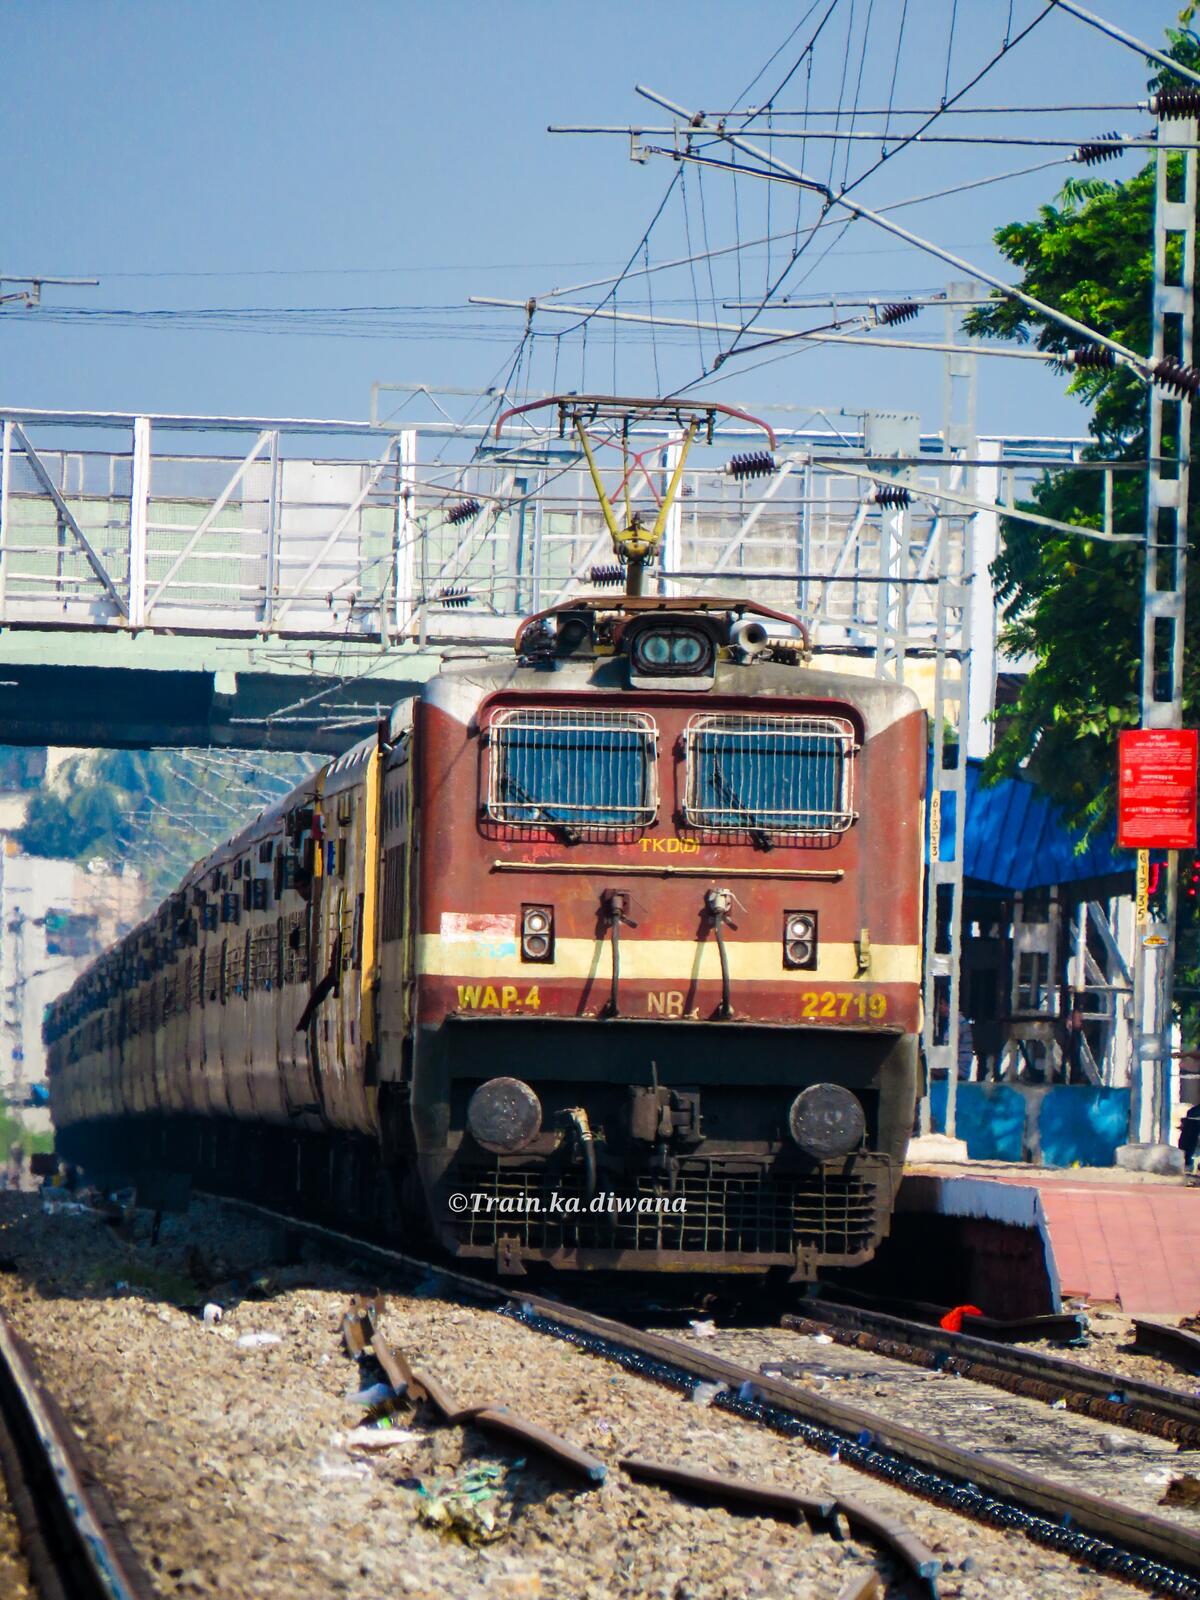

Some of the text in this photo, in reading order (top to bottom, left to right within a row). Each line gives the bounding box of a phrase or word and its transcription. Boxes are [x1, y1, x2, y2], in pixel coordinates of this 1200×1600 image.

[639, 837, 700, 854] TKD(D)
[647, 990, 684, 1015] NR
[801, 991, 887, 1018] 22719
